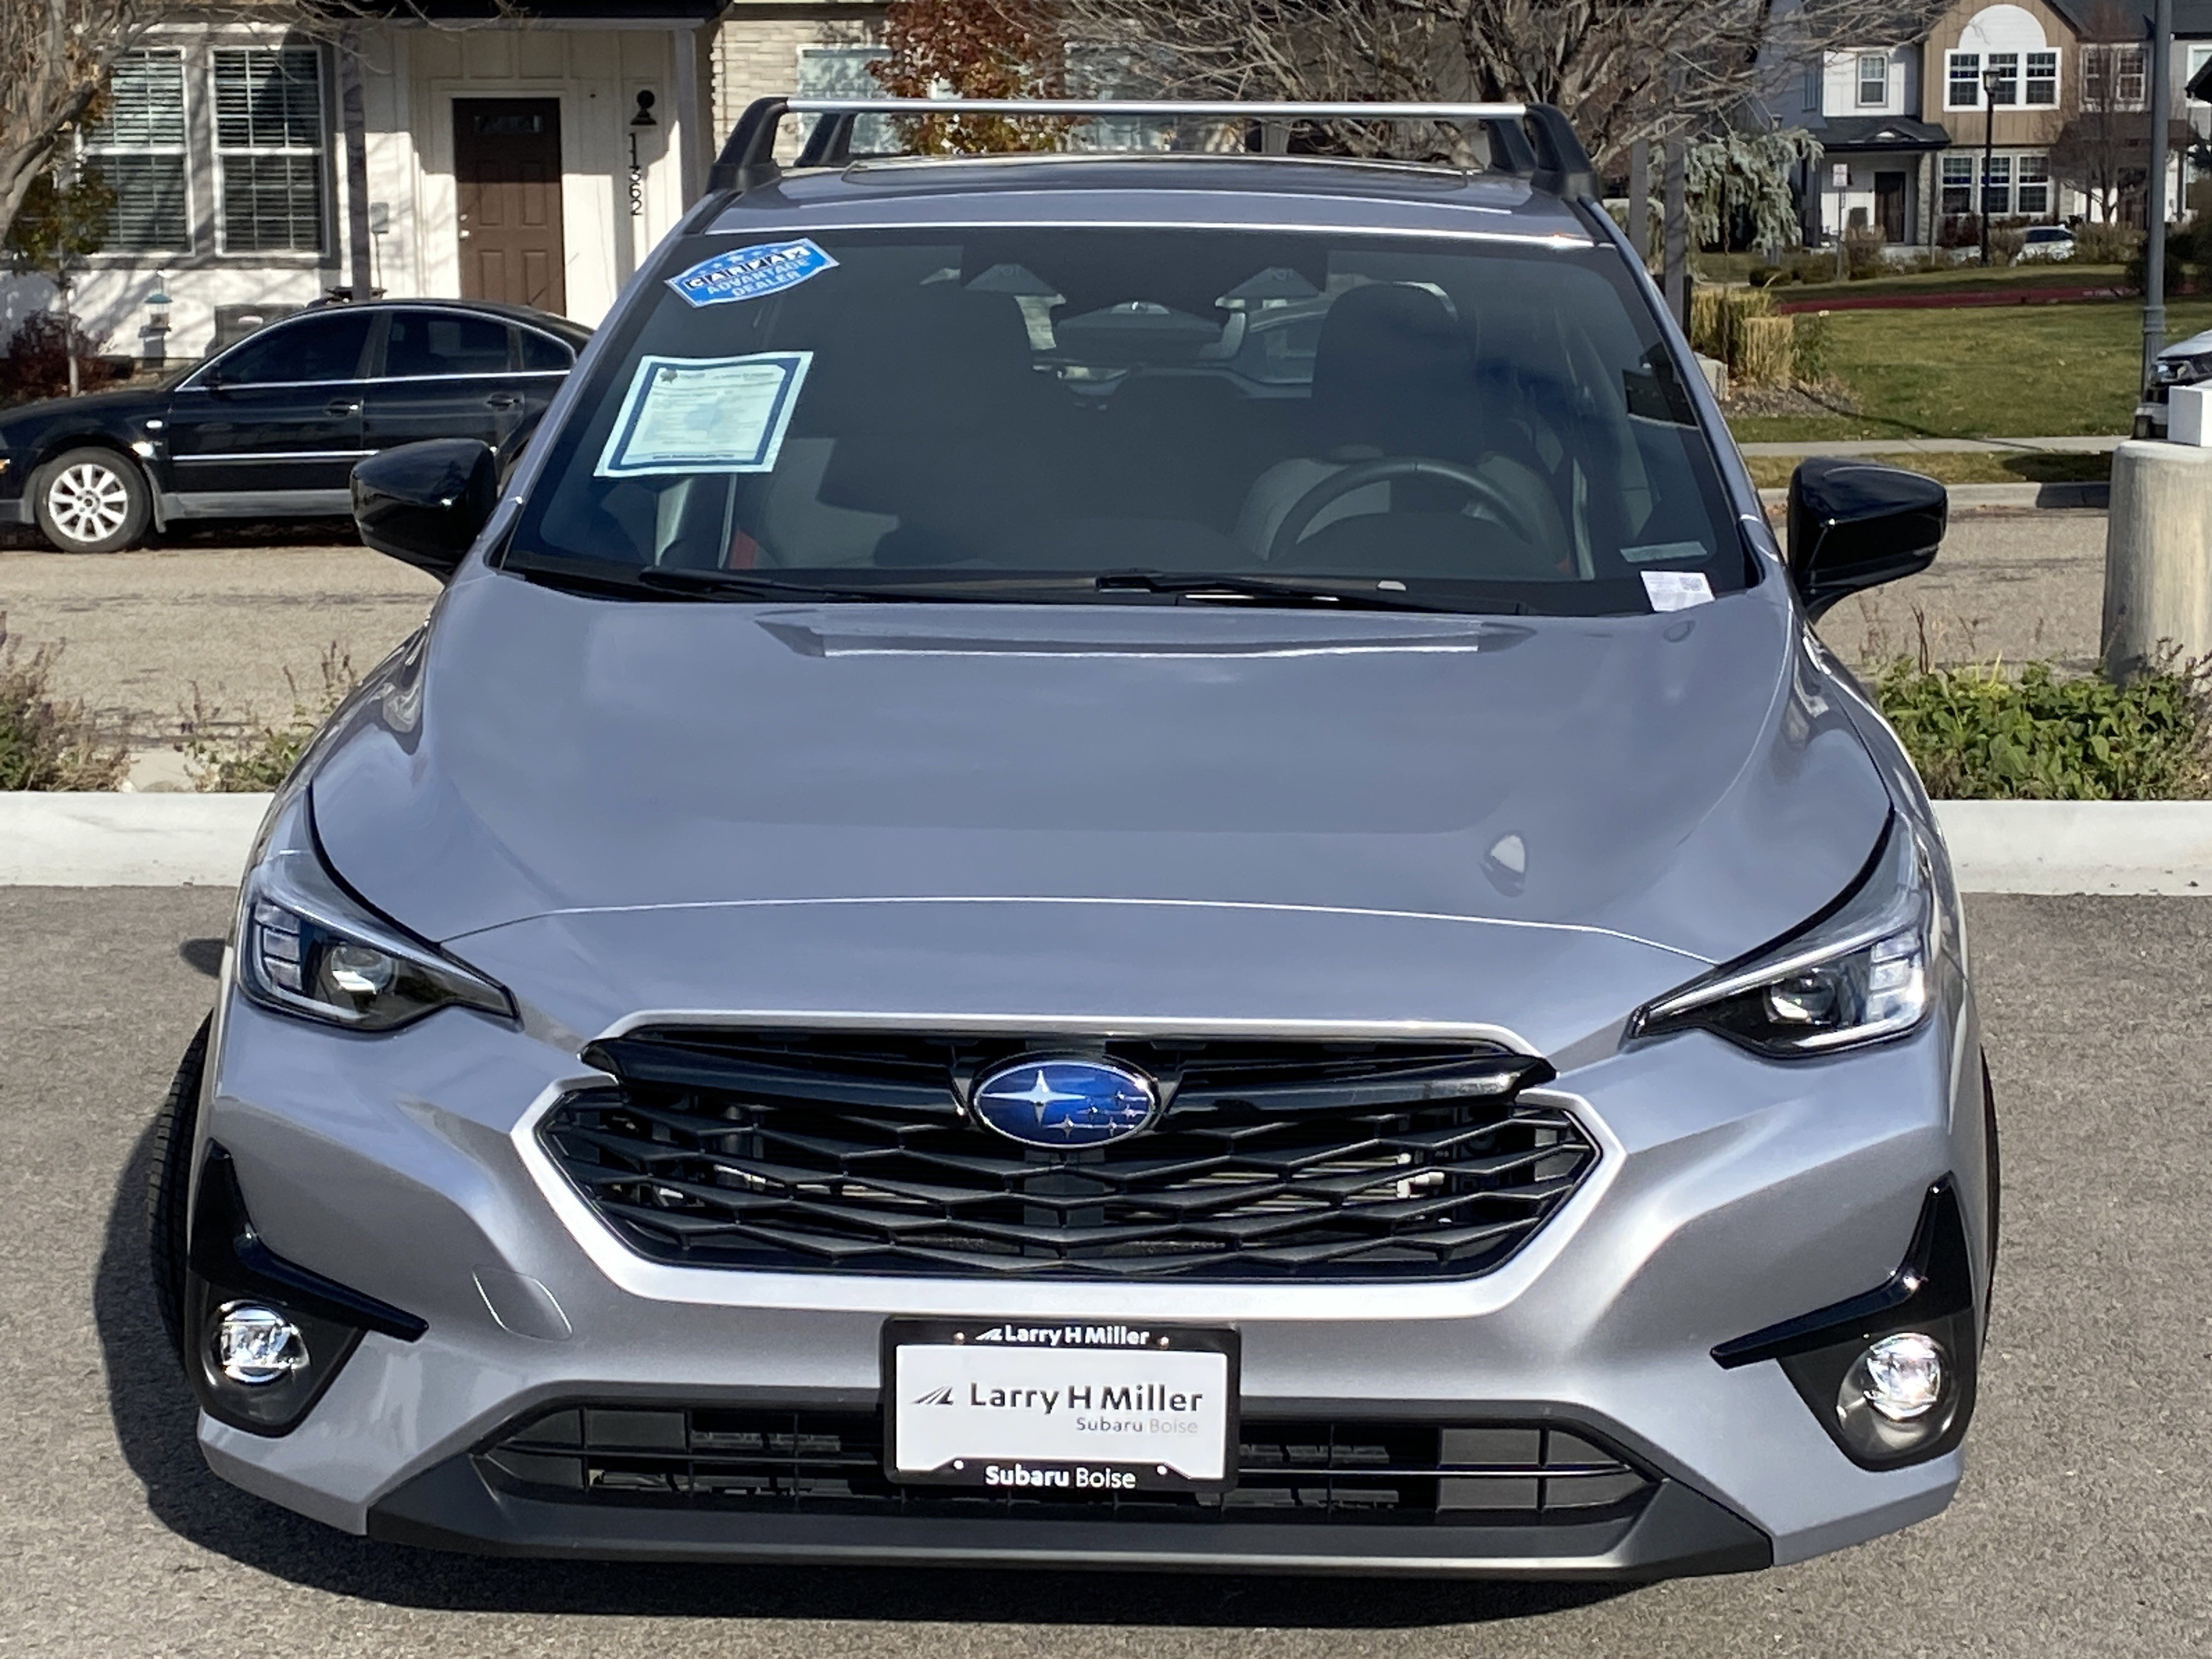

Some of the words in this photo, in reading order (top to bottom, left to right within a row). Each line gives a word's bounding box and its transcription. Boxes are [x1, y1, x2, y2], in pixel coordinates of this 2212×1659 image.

[707, 258, 809, 295] ADVANTAGE
[731, 271, 802, 297] DEALER
[1005, 1325, 1062, 1346] Larry
[1065, 1328, 1082, 1344] H
[1084, 1326, 1150, 1346] Miller
[970, 1383, 1059, 1415] Larry
[1068, 1385, 1091, 1410] H
[1100, 1384, 1203, 1413] Miller
[1076, 1417, 1143, 1433] Subaru
[1149, 1418, 1198, 1434] Boise
[985, 1464, 1069, 1487] Subaru
[1075, 1466, 1136, 1488] Boise
